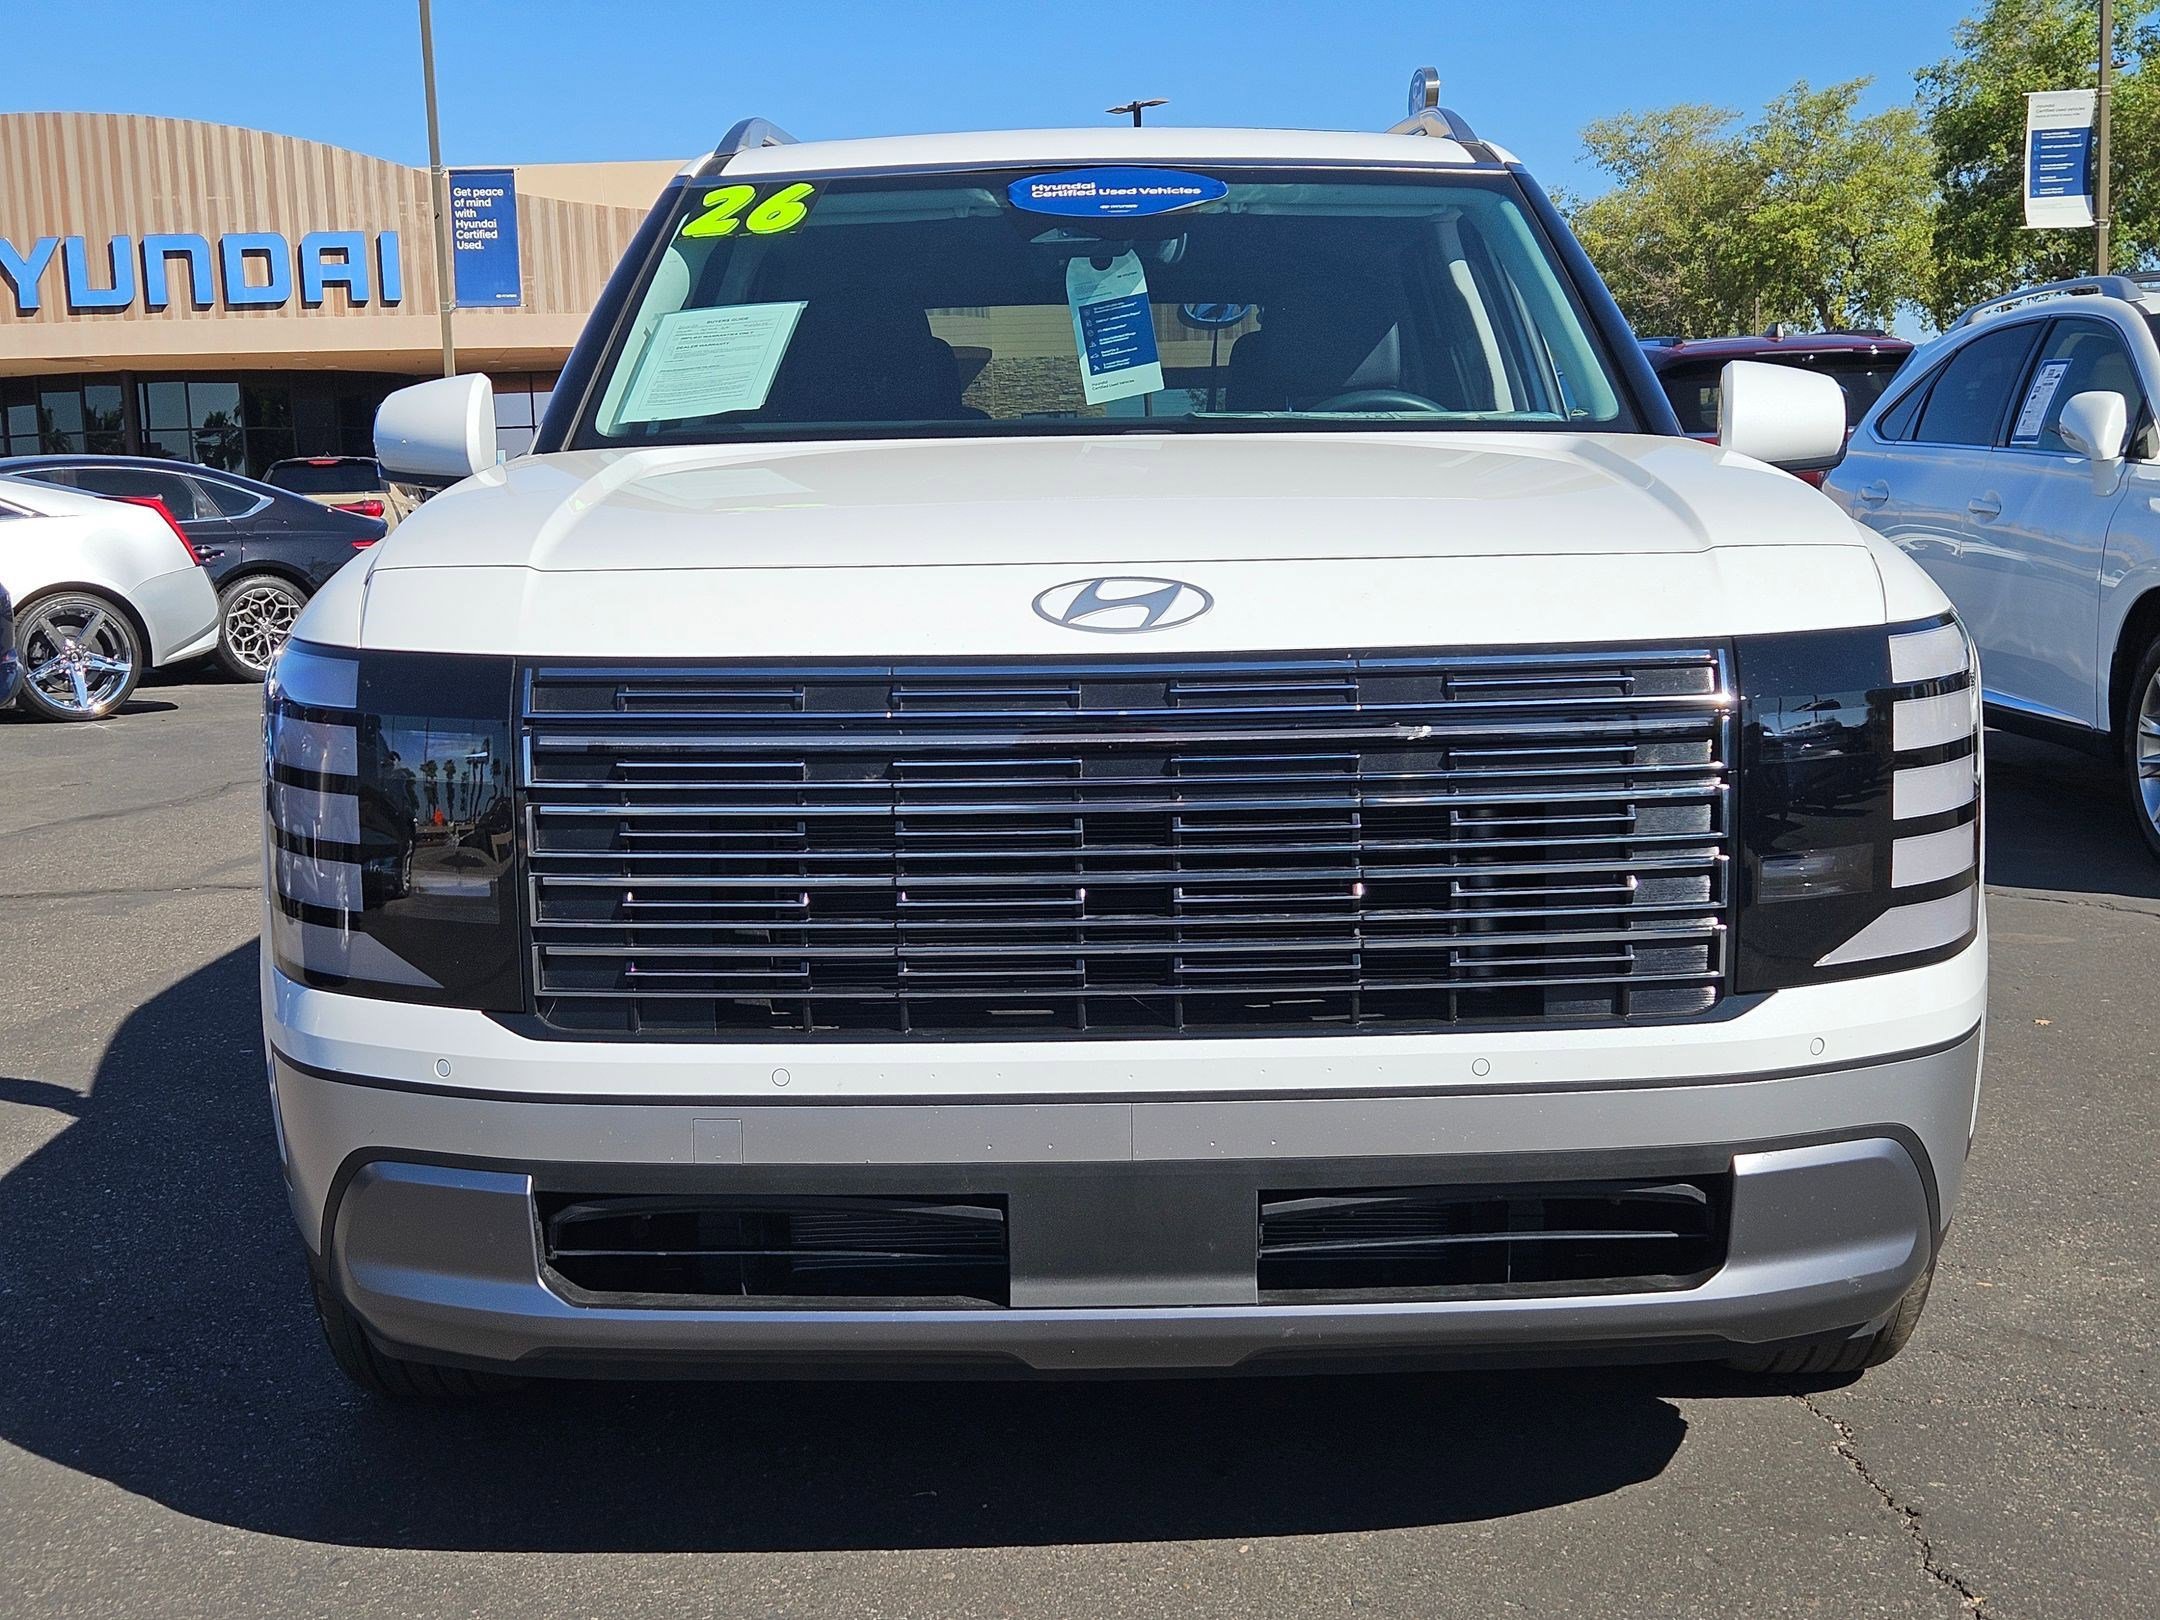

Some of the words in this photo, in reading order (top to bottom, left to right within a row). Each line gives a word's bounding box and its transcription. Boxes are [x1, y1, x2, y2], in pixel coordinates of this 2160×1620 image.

[1031, 182, 1096, 191] Hyundai
[453, 187, 471, 197] Get
[472, 188, 504, 198] peace
[1031, 190, 1096, 198] Certified
[1139, 187, 1202, 195] Vehicles
[454, 197, 465, 207] of
[466, 197, 491, 207] mind
[454, 208, 477, 218] with
[682, 182, 815, 237] 26
[455, 218, 497, 230] Hyundai
[456, 229, 498, 239] Certified
[456, 240, 485, 250] Used.
